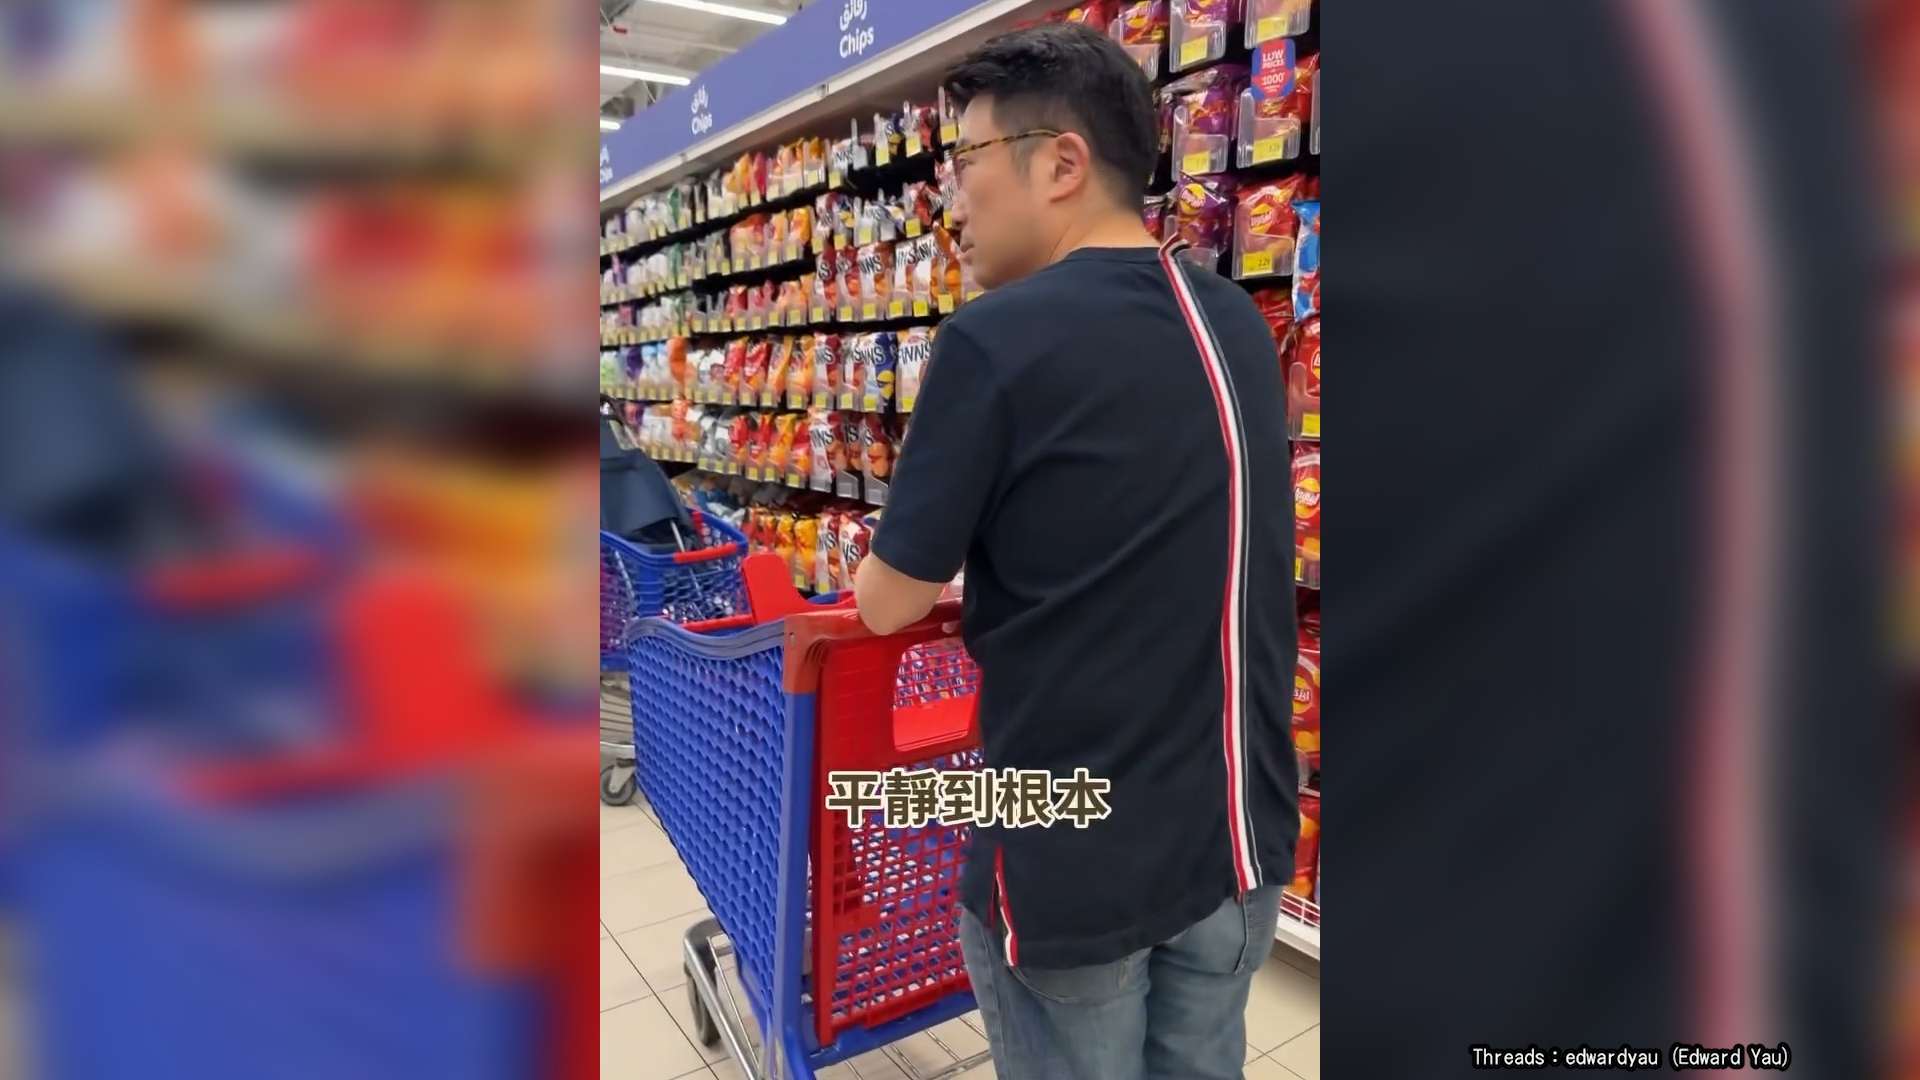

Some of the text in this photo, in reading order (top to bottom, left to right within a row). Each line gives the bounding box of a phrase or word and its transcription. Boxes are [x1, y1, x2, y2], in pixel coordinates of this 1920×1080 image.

[839, 26, 874, 58] Chips
[1262, 49, 1284, 62] LOW
[691, 113, 713, 135] Chips
